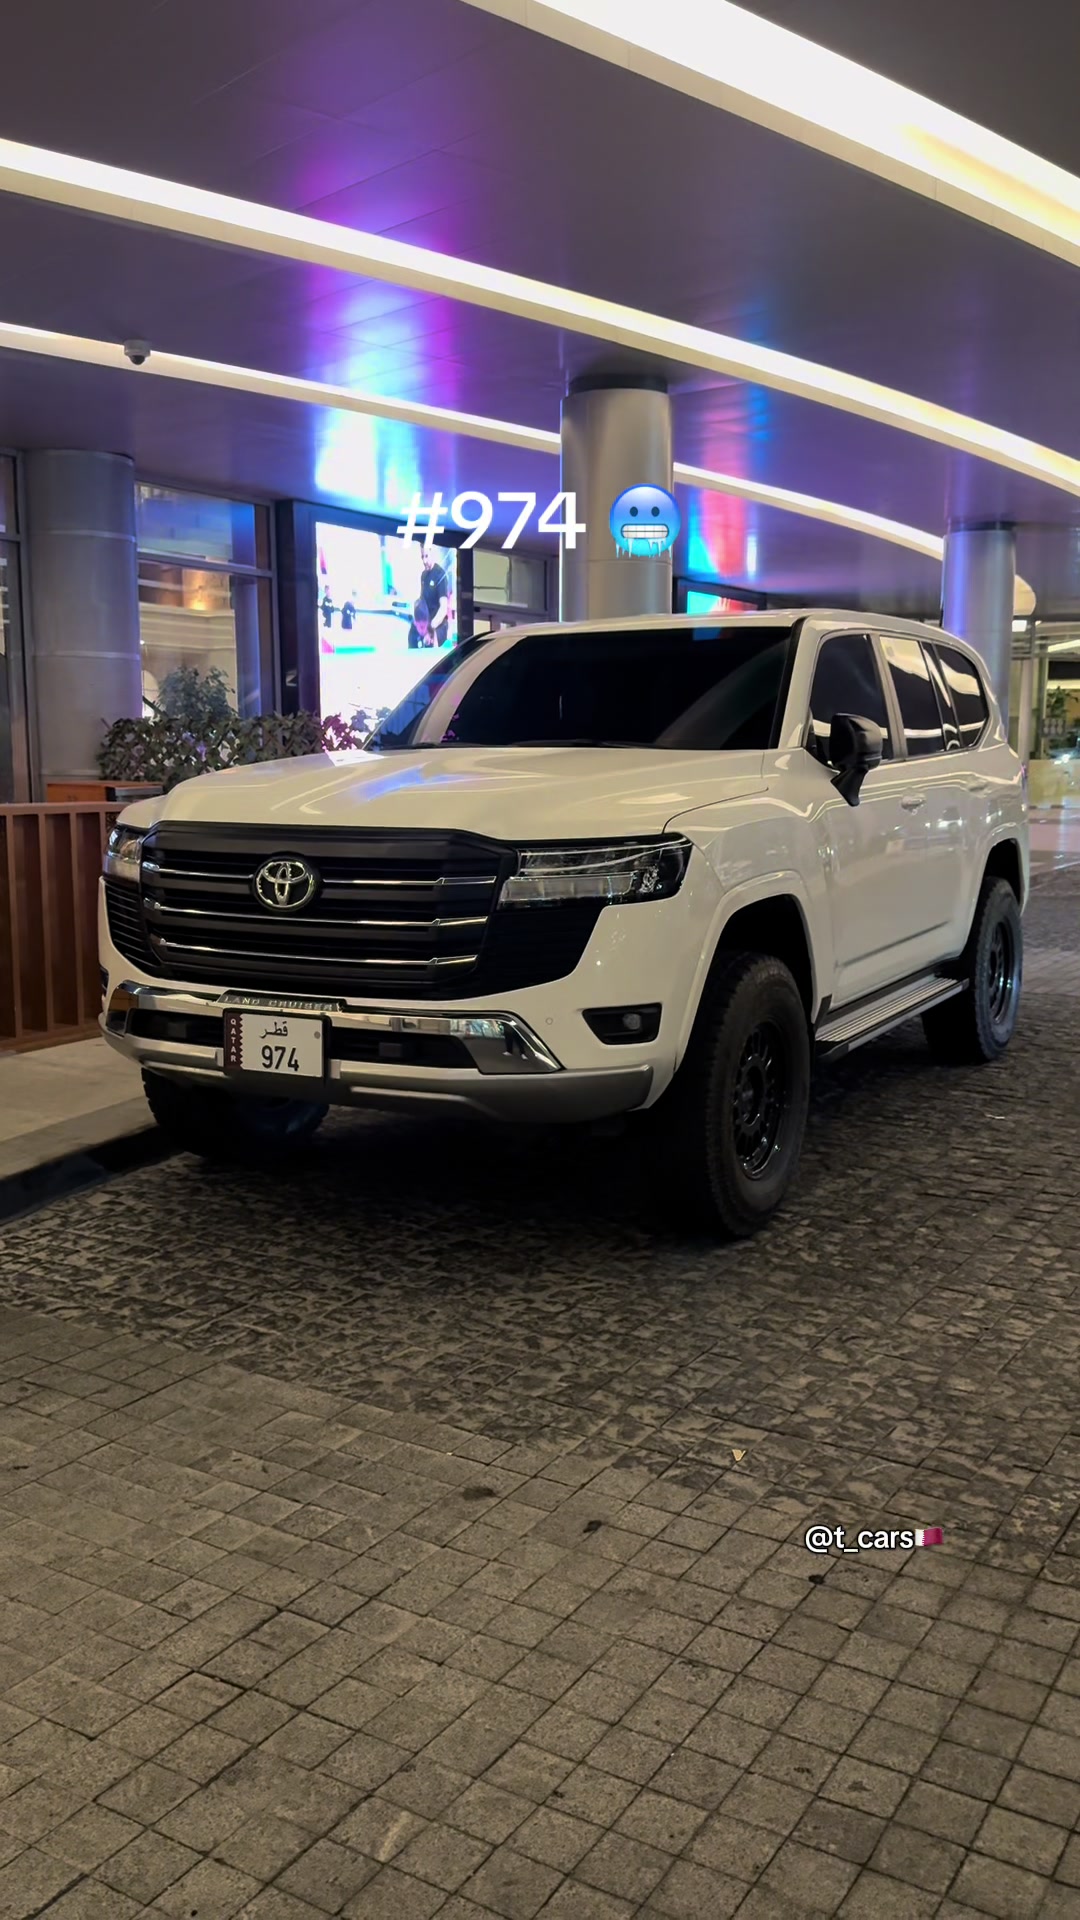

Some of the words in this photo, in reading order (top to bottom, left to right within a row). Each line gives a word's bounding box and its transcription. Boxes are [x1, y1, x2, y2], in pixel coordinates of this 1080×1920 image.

[223, 995, 260, 1005] LAND
[268, 999, 333, 1012] CRUISER
[259, 1021, 289, 1039] قطر
[261, 1045, 300, 1071] 974
